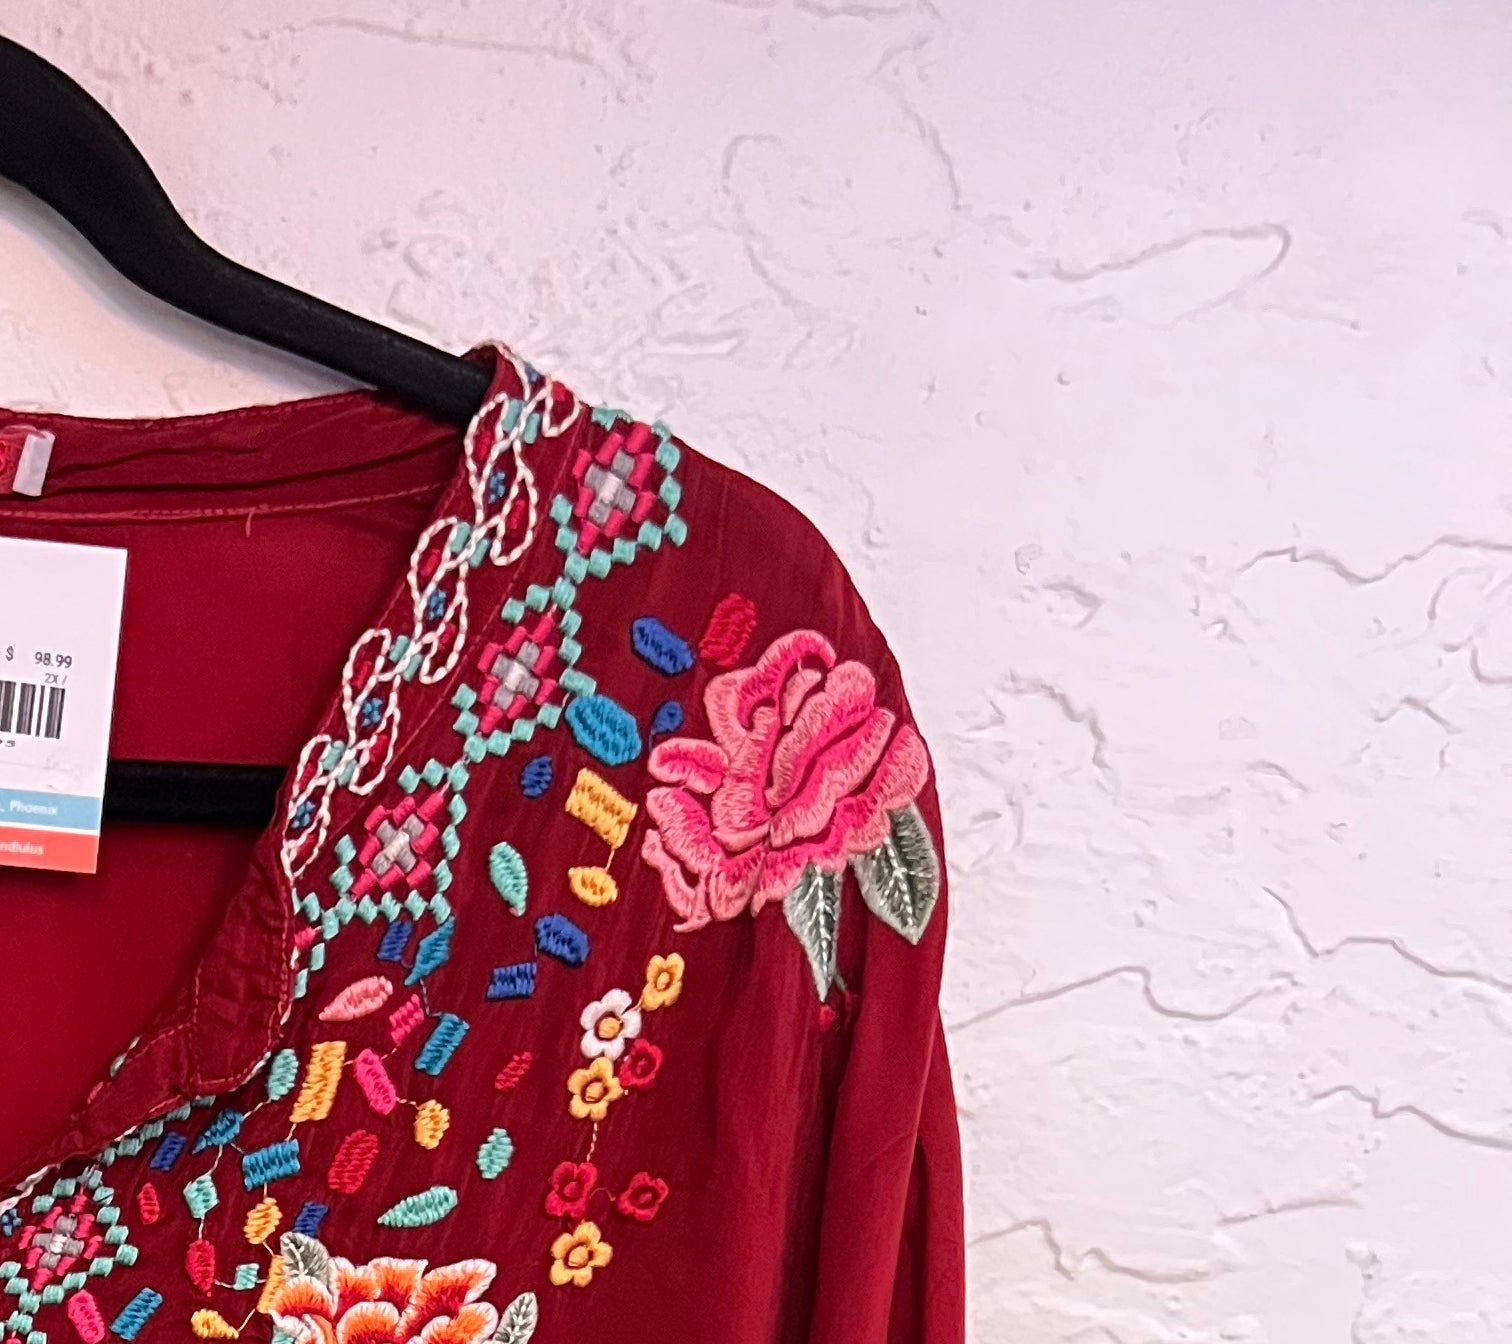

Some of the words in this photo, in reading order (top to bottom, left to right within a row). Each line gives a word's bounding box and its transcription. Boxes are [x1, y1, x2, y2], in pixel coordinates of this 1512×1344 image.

[5, 646, 15, 662] $
[35, 651, 72, 669] 98.99
[44, 673, 59, 685] 2X
[10, 800, 58, 816] Phoenix
